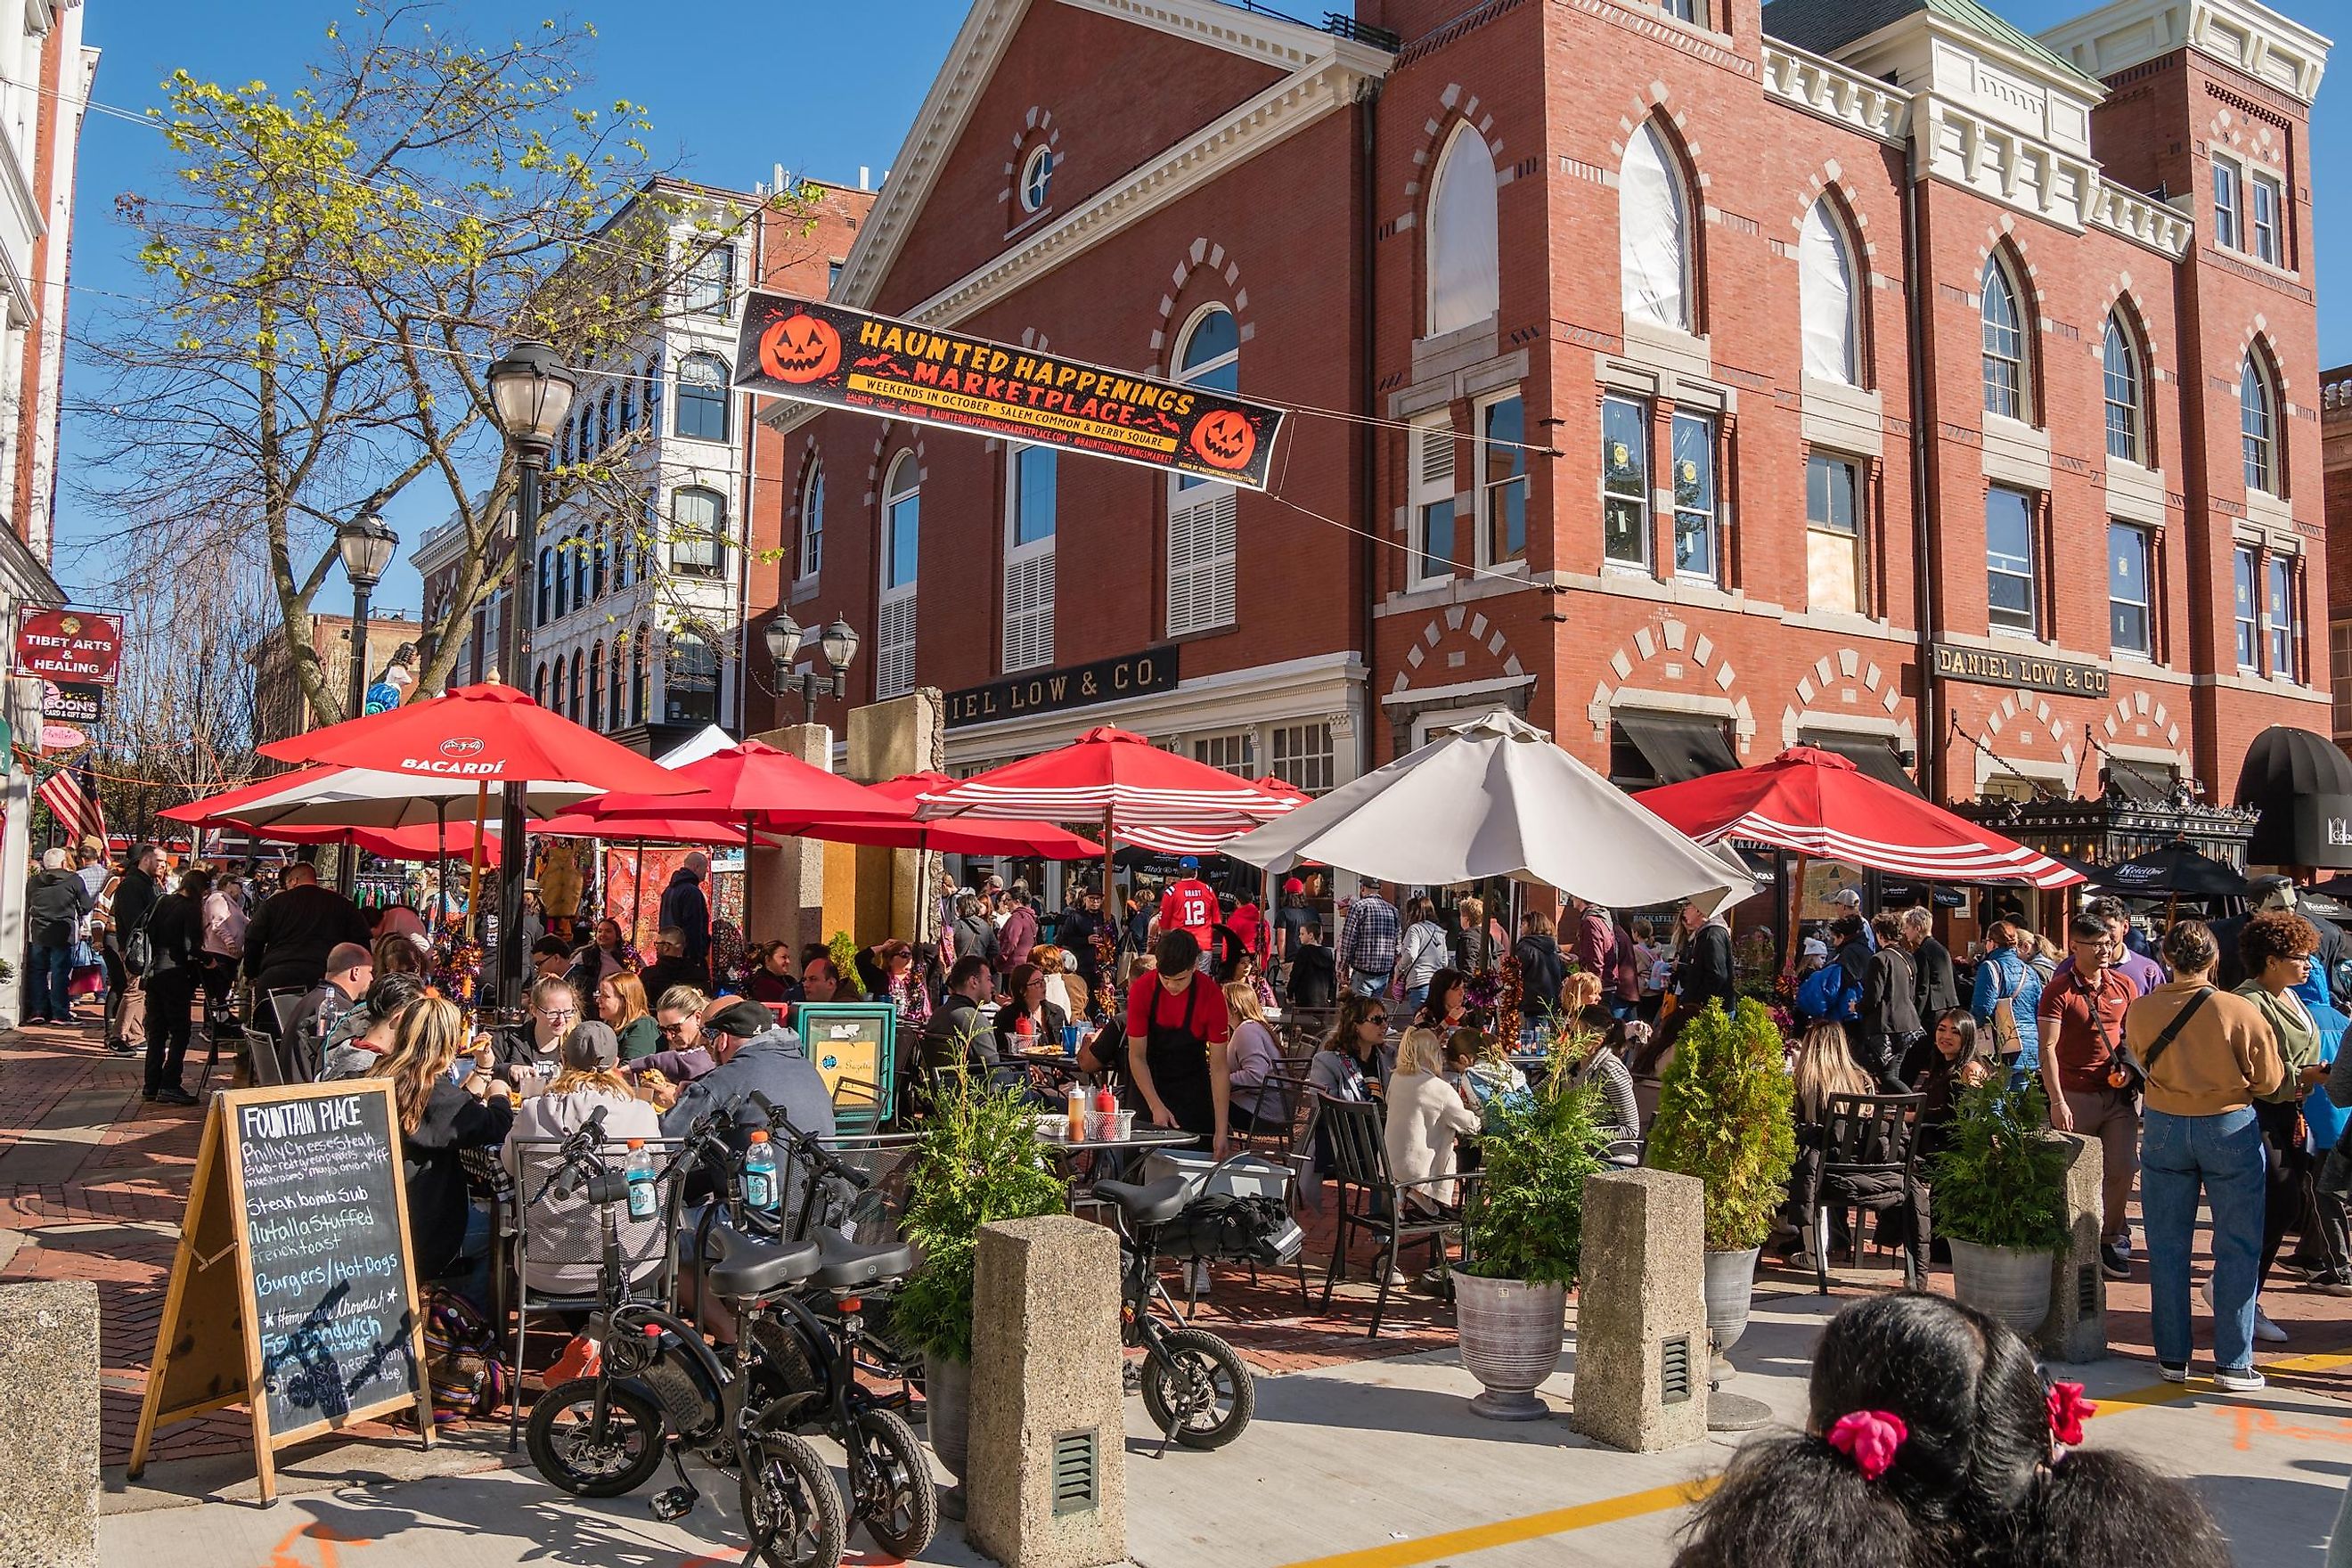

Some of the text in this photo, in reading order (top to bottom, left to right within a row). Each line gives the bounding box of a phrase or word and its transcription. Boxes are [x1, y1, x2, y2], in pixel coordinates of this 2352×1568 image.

[860, 321, 1195, 415] HAUNTED HAPPENINGS
[846, 393, 868, 403] SALEM
[913, 361, 1136, 426] MARKETPLACE
[867, 379, 1164, 447] WEEKENDS IN OCTOBER SALEM COMMON & DERBY SQUARE
[26, 634, 112, 652] TIBET ARTS
[61, 650, 73, 660] &
[34, 659, 100, 674] HEALING
[1940, 649, 2109, 691] DANIEL LOW & CO.
[943, 657, 1163, 720] IEL LOW & CO.
[67, 711, 80, 719] GIFT
[80, 712, 97, 720] SHOP
[401, 758, 506, 774] BACARDÍ
[1972, 815, 2100, 827] OCKAFELLAS
[1184, 889, 1202, 898] BRADY
[1183, 901, 1205, 926] 12
[243, 1096, 363, 1139] FOUNTAIN PLACE
[246, 1196, 297, 1216] Steak
[298, 1190, 335, 1208] bomb
[299, 1235, 342, 1254] toast
[364, 1252, 397, 1277] Dogs
